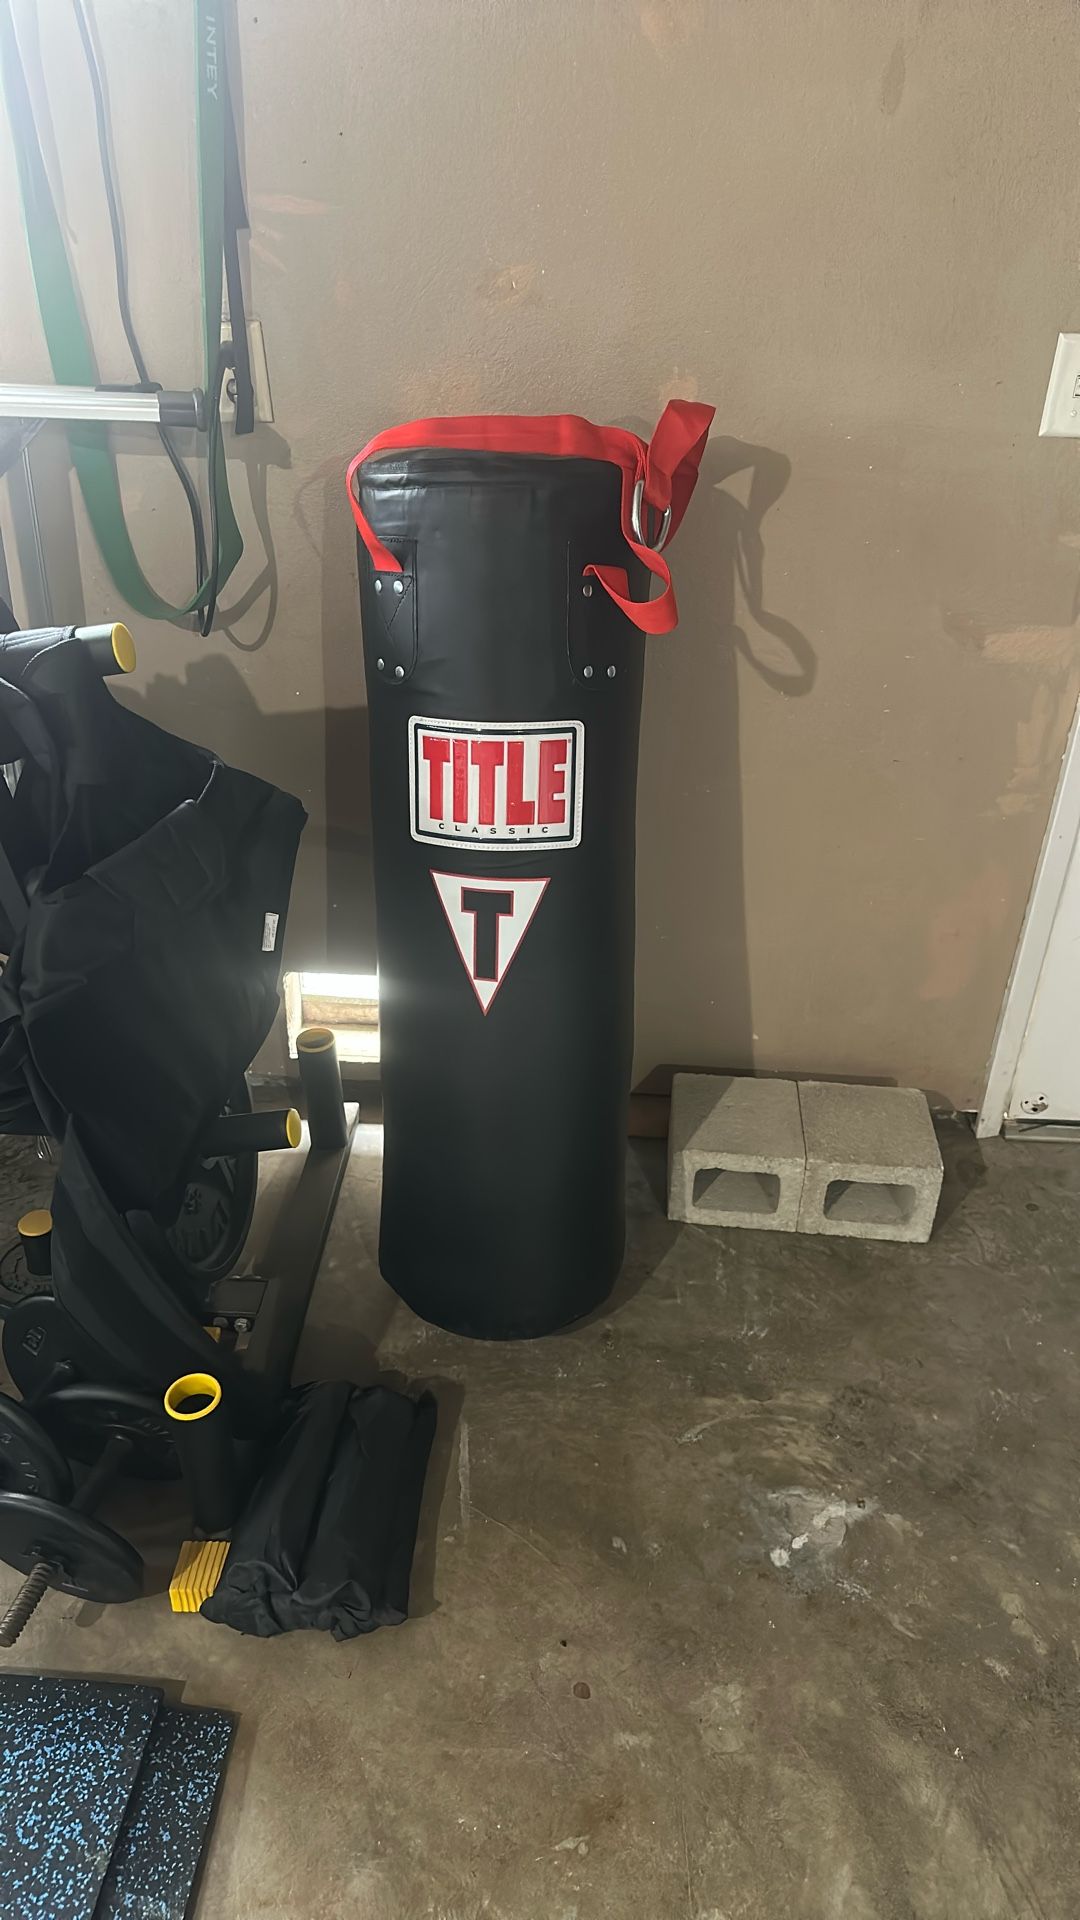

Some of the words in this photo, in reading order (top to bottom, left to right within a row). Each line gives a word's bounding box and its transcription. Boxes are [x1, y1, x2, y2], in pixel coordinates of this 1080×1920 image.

[205, 15, 218, 101] INTEY
[422, 735, 568, 826] TITLE
[438, 822, 549, 835] CLASSIC
[460, 886, 514, 983] T
